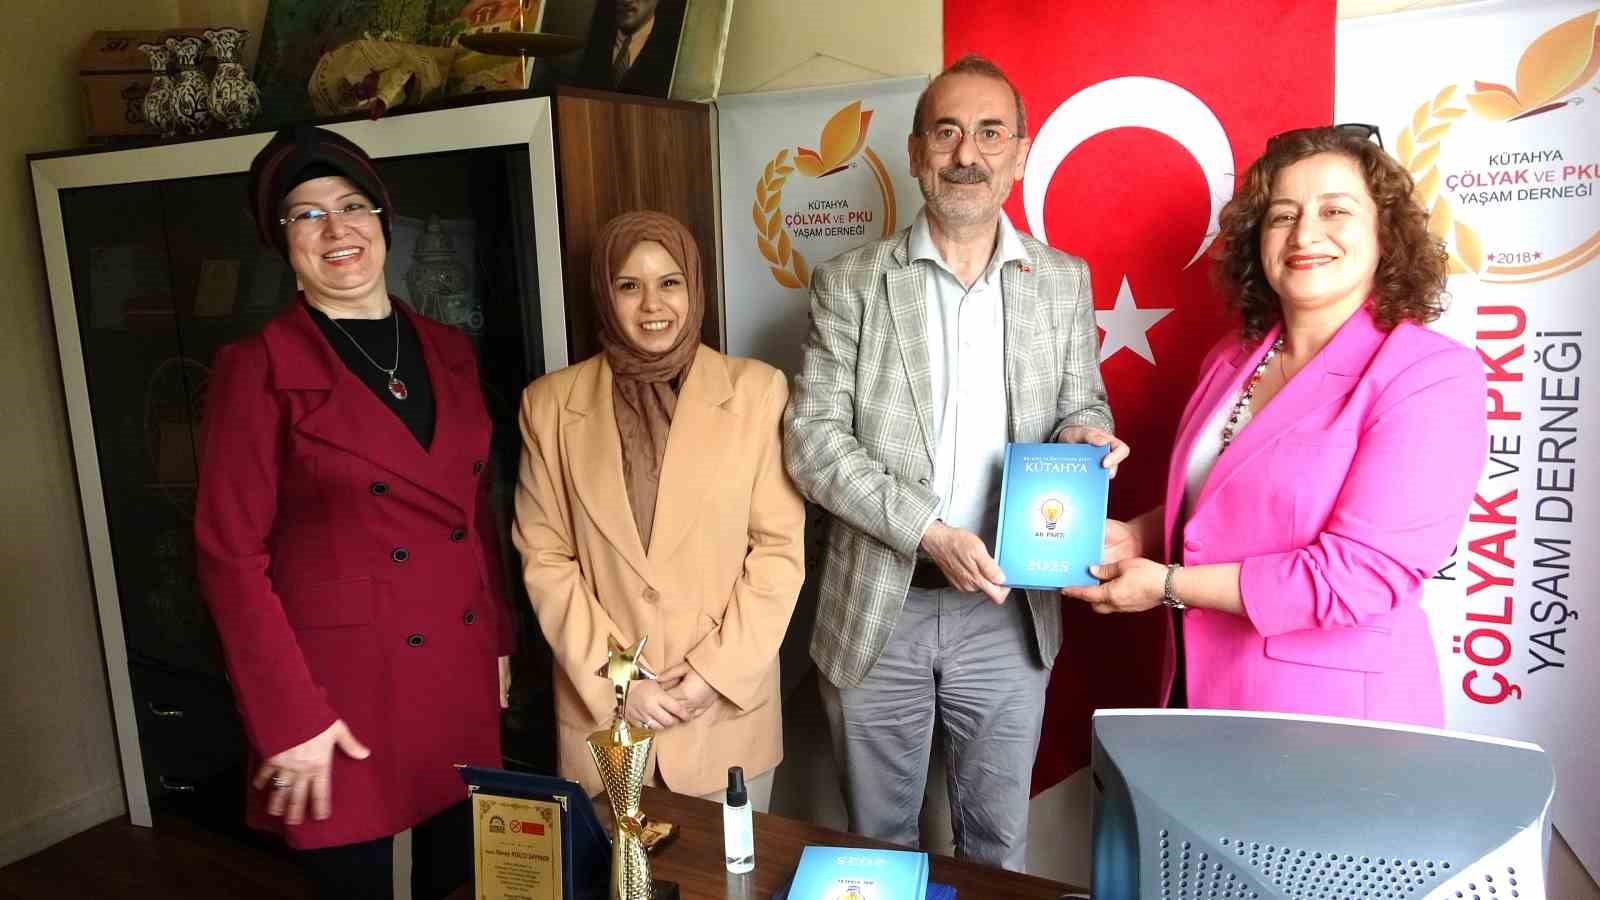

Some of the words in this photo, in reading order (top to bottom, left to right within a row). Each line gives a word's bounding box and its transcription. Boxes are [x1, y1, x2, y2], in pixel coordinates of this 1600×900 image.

[1489, 149, 1563, 167] KÜTAHYA
[1446, 168, 1529, 192] ÇÖLYAK
[1534, 170, 1555, 183] VE
[808, 199, 849, 210] KÜTAHYA
[1459, 189, 1512, 206] YAŞAM
[1517, 182, 1592, 201] DERNEĞİ
[785, 212, 831, 228] ÇÖLYAK
[833, 214, 845, 224] VE
[848, 211, 873, 223] PKU
[793, 228, 823, 239] YAŞAM
[825, 224, 865, 237] DERNEĞİ
[1496, 252, 1532, 264] 2018
[1476, 305, 1527, 421] PKU
[1534, 330, 1582, 523] DERNEĞİ
[1488, 434, 1521, 480] VE
[1453, 488, 1522, 705] ÇÖLYAK
[1527, 537, 1578, 674] YAŞAM
